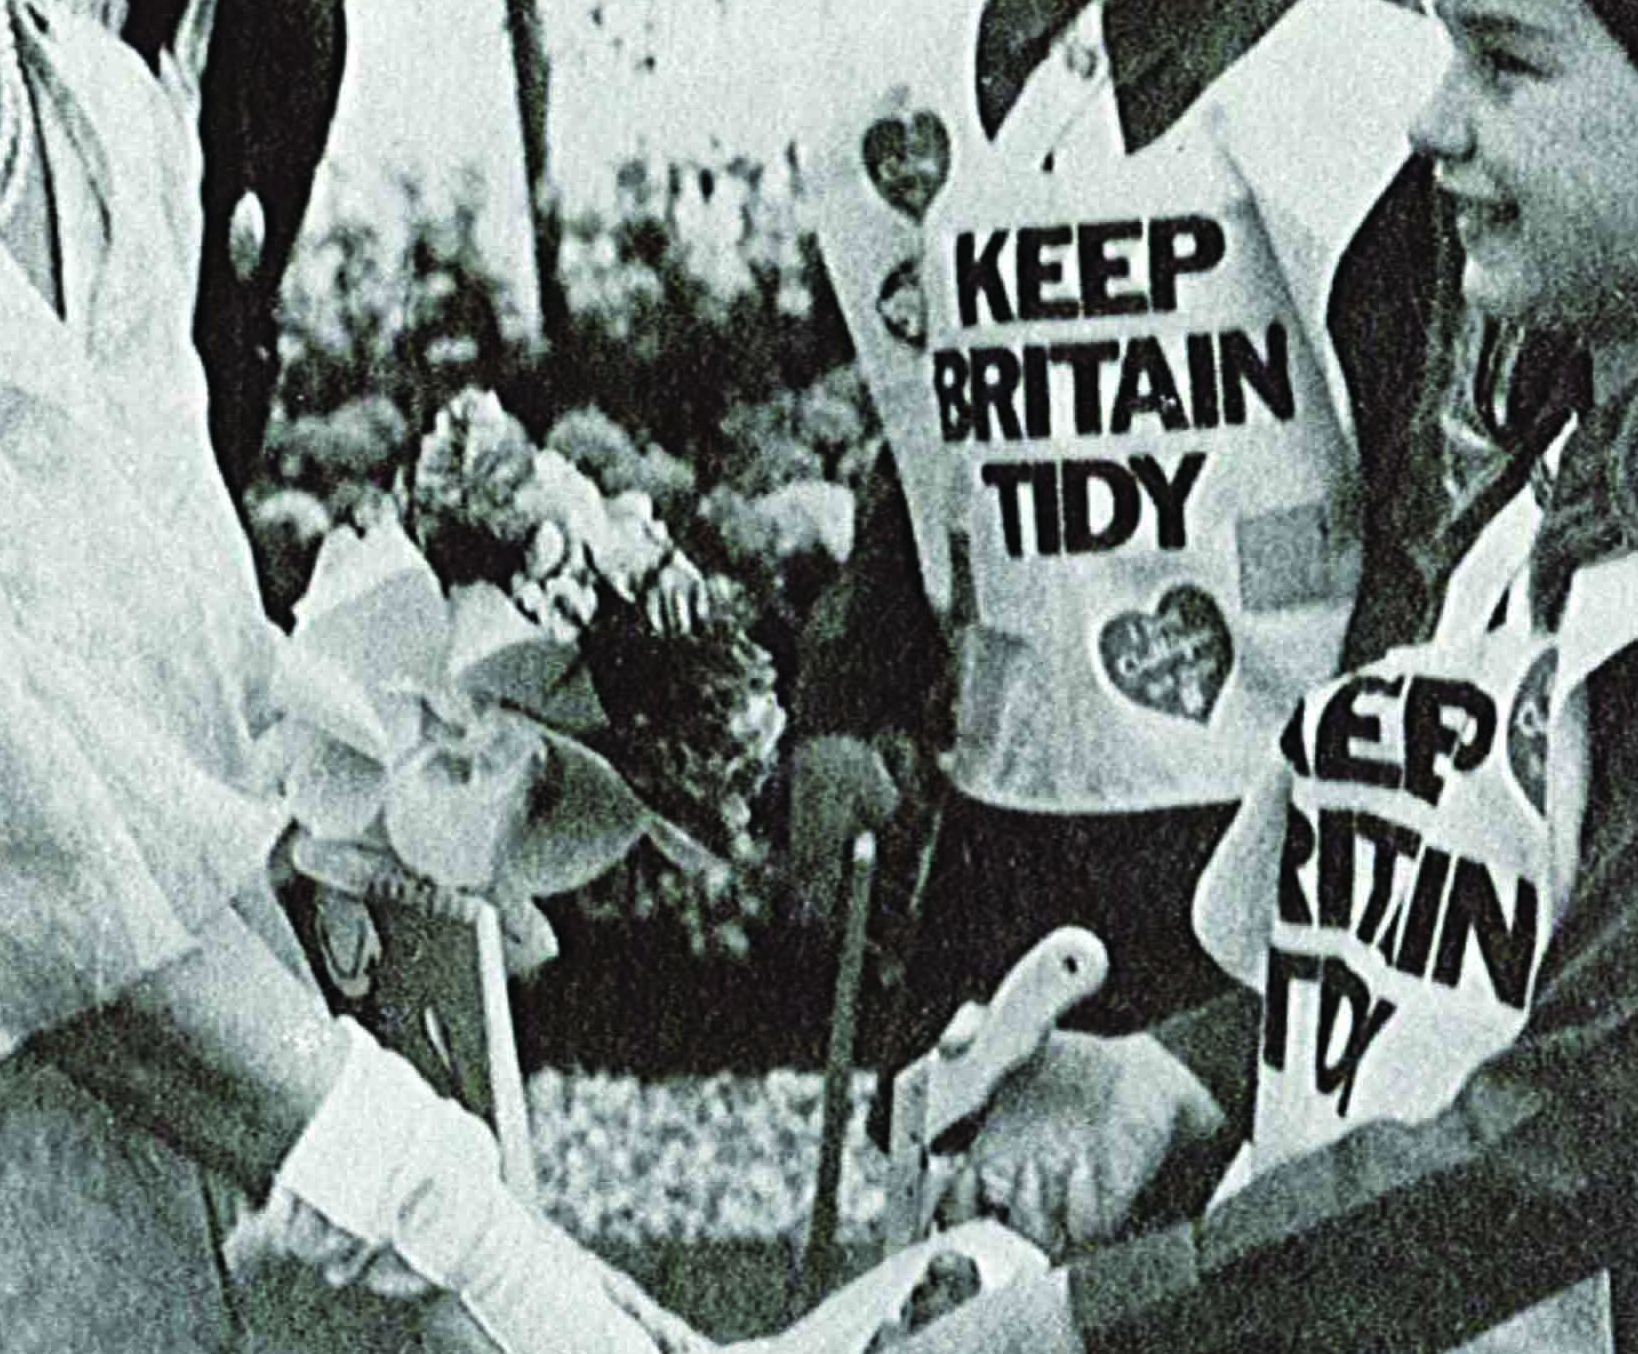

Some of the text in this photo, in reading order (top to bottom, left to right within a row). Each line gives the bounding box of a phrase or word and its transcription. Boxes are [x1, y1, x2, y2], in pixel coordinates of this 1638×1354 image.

[955, 214, 1225, 328] KEEP
[933, 322, 1295, 444] BRITAIN
[982, 454, 1206, 558] TIDY
